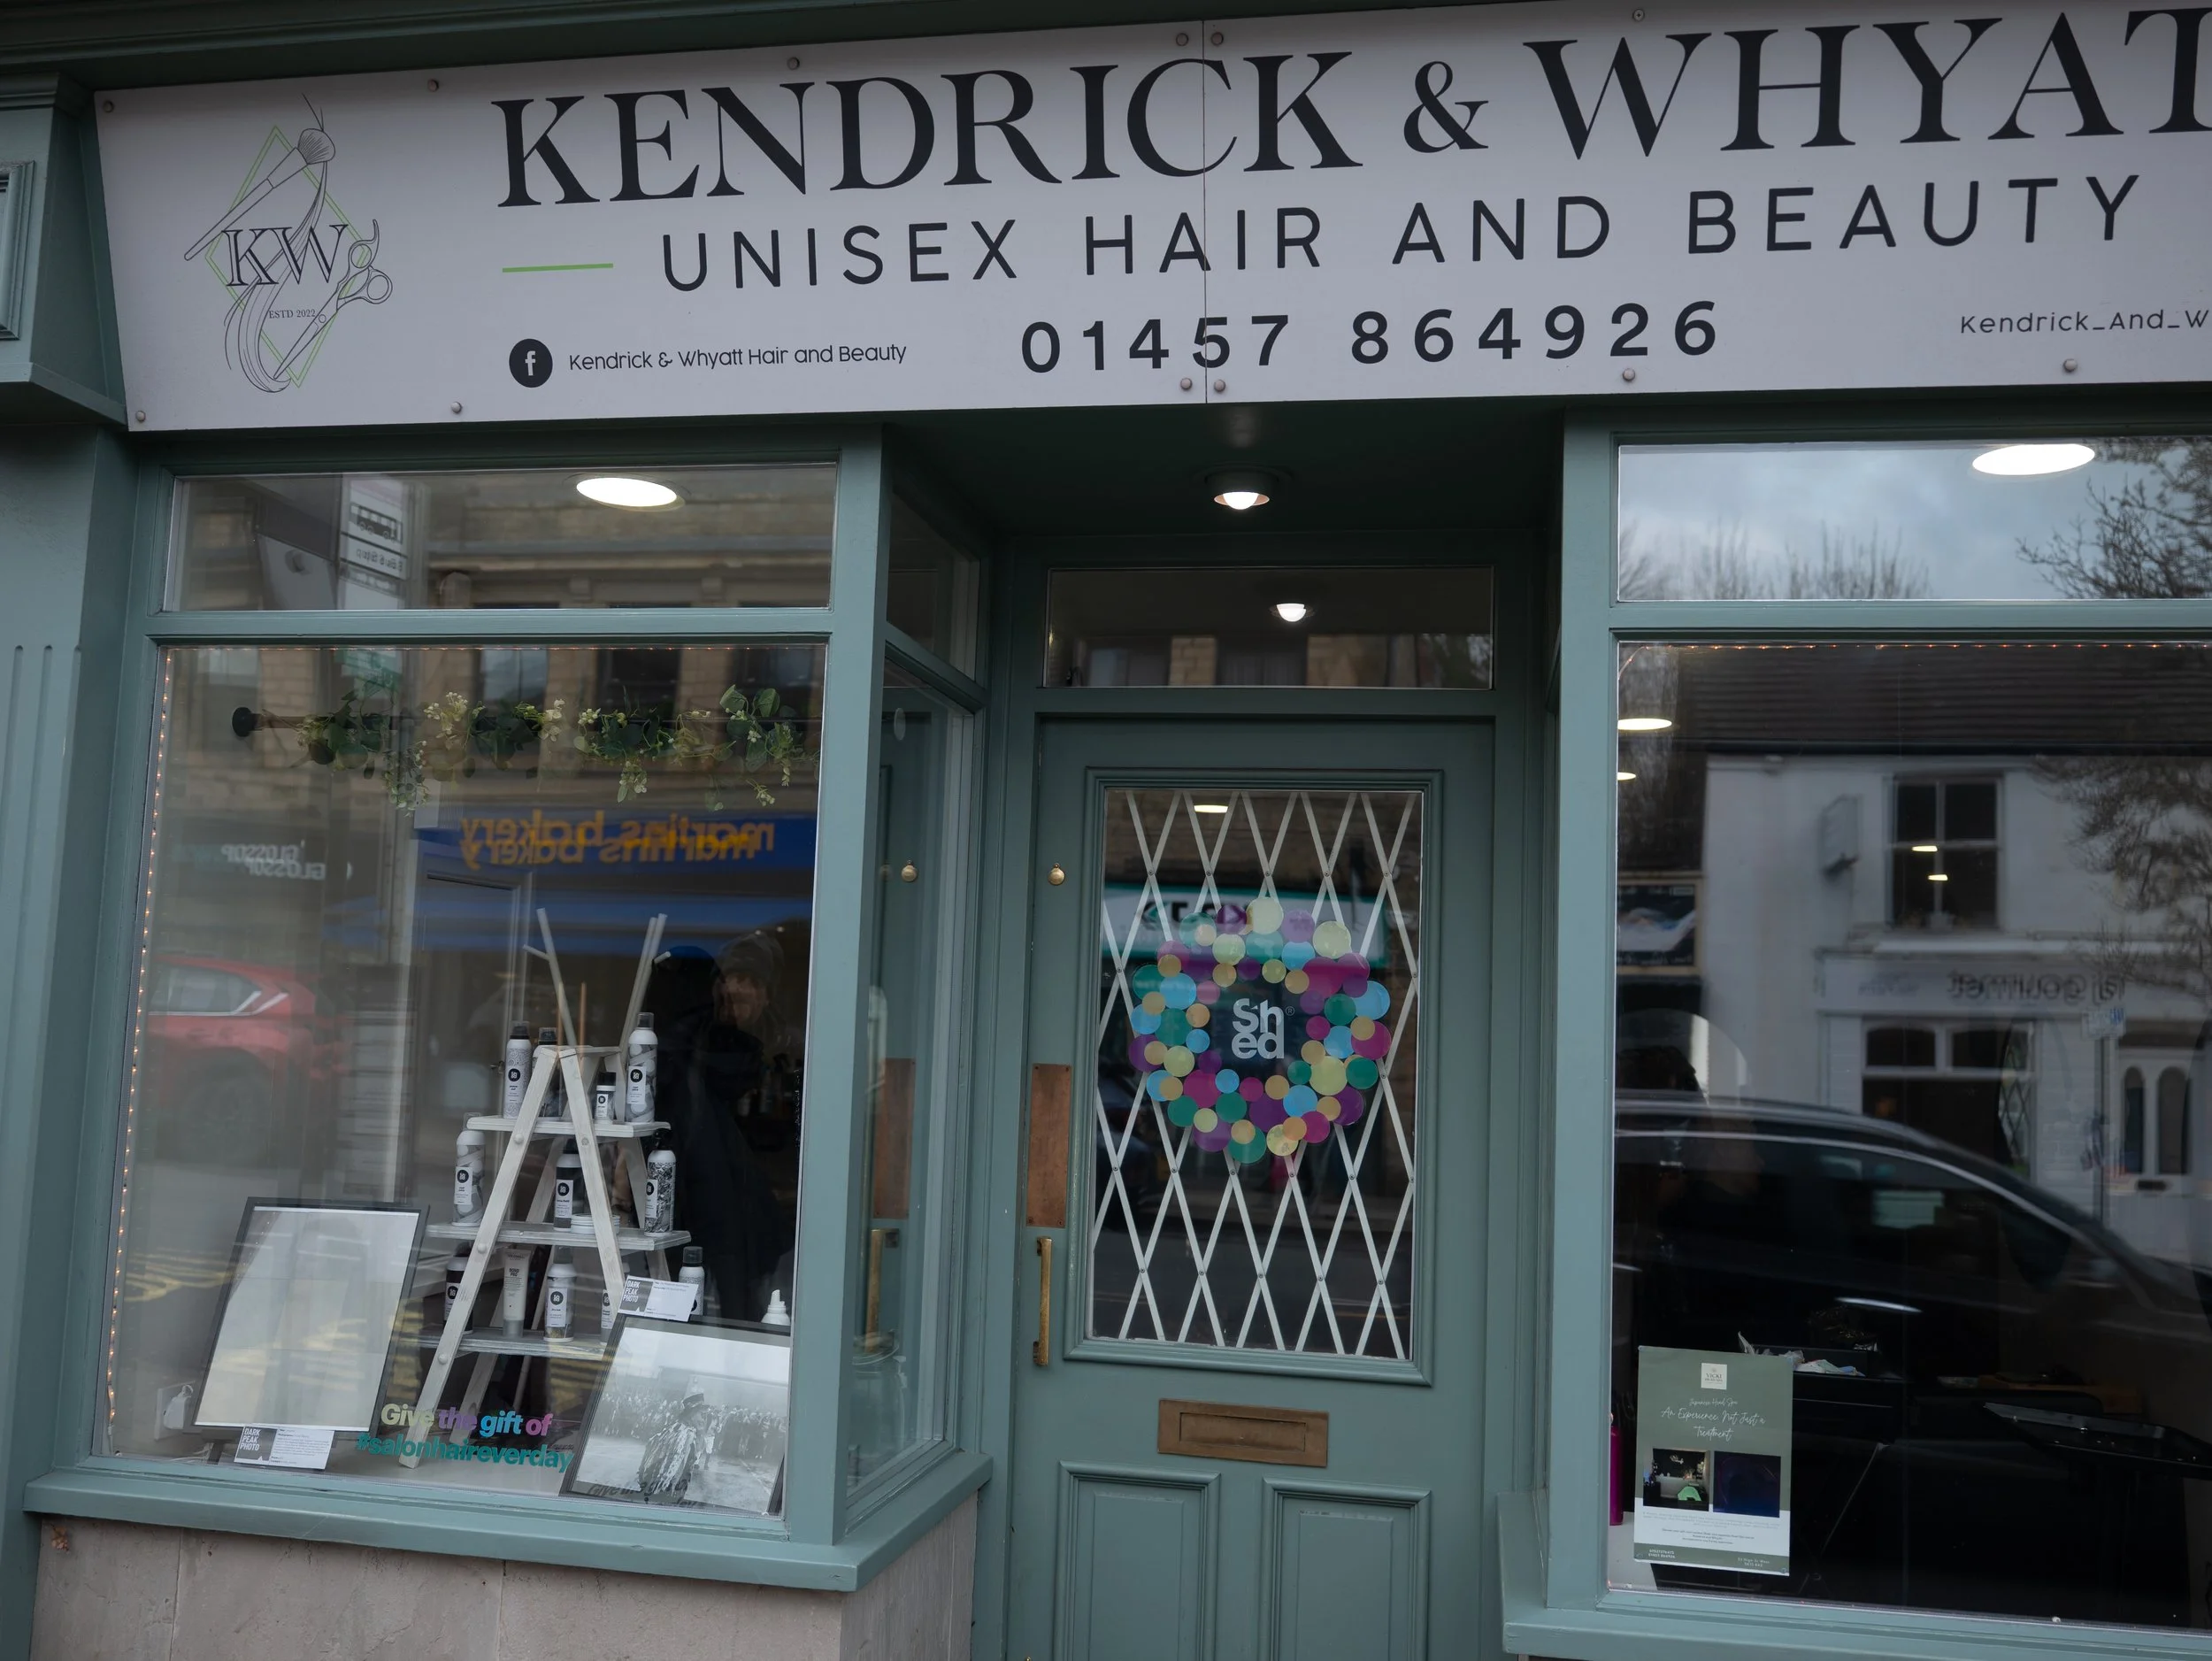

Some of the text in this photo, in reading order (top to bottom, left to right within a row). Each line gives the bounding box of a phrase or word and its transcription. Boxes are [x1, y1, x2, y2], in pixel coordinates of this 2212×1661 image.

[490, 7, 2212, 208] KENDRICK & WHYAT
[663, 175, 2139, 292] UNISEX HAIR AND BEAUTY
[221, 224, 349, 287] KW
[268, 310, 316, 319] ESTD 2022
[1961, 309, 2209, 335] Kendrick_And_W
[1021, 301, 1716, 374] 01457 864926
[569, 343, 907, 371] Kendrick & Whyatt Hair and Beauty
[626, 1280, 641, 1289] DARK
[380, 1403, 554, 1438] Give the gift of
[1661, 1406, 1676, 1419] An
[1721, 1410, 1740, 1426] Not
[1739, 1412, 1760, 1426] Just
[242, 1435, 259, 1444] PEAK
[244, 1427, 262, 1437] DARK
[1694, 1425, 1735, 1442] Treatment
[239, 1442, 261, 1451] PHOTO
[355, 1432, 575, 1473] #salonhaireverday
